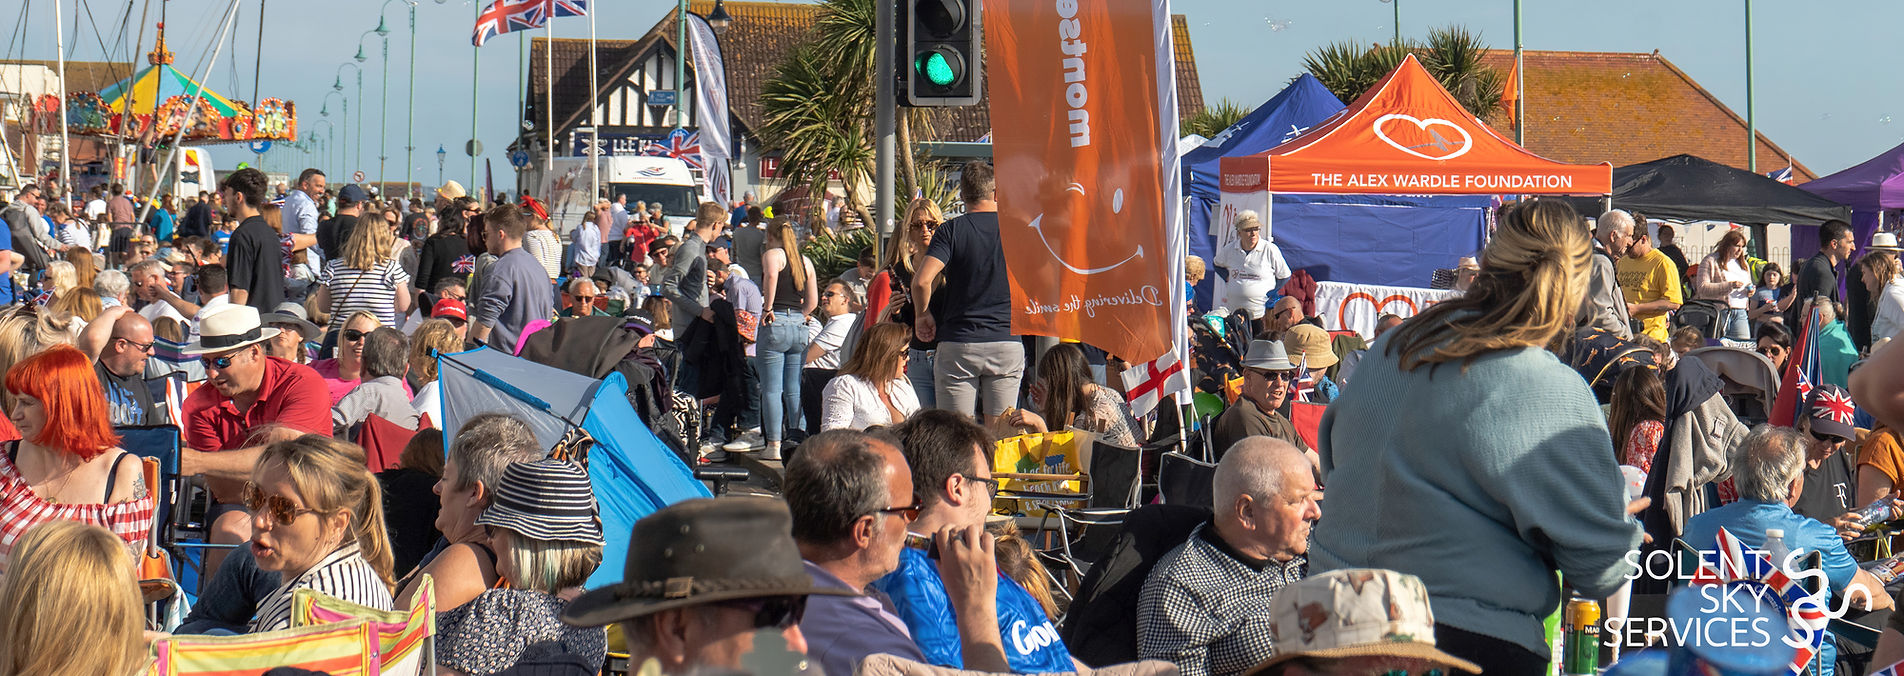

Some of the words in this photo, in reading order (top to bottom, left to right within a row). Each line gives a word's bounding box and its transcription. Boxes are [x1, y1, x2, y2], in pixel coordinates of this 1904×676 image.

[613, 139, 636, 152] LEE
[1311, 173, 1343, 188] THE
[1347, 174, 1389, 188] ALEX
[1390, 174, 1460, 188] WARDLE
[1465, 175, 1572, 189] FOUNDATION
